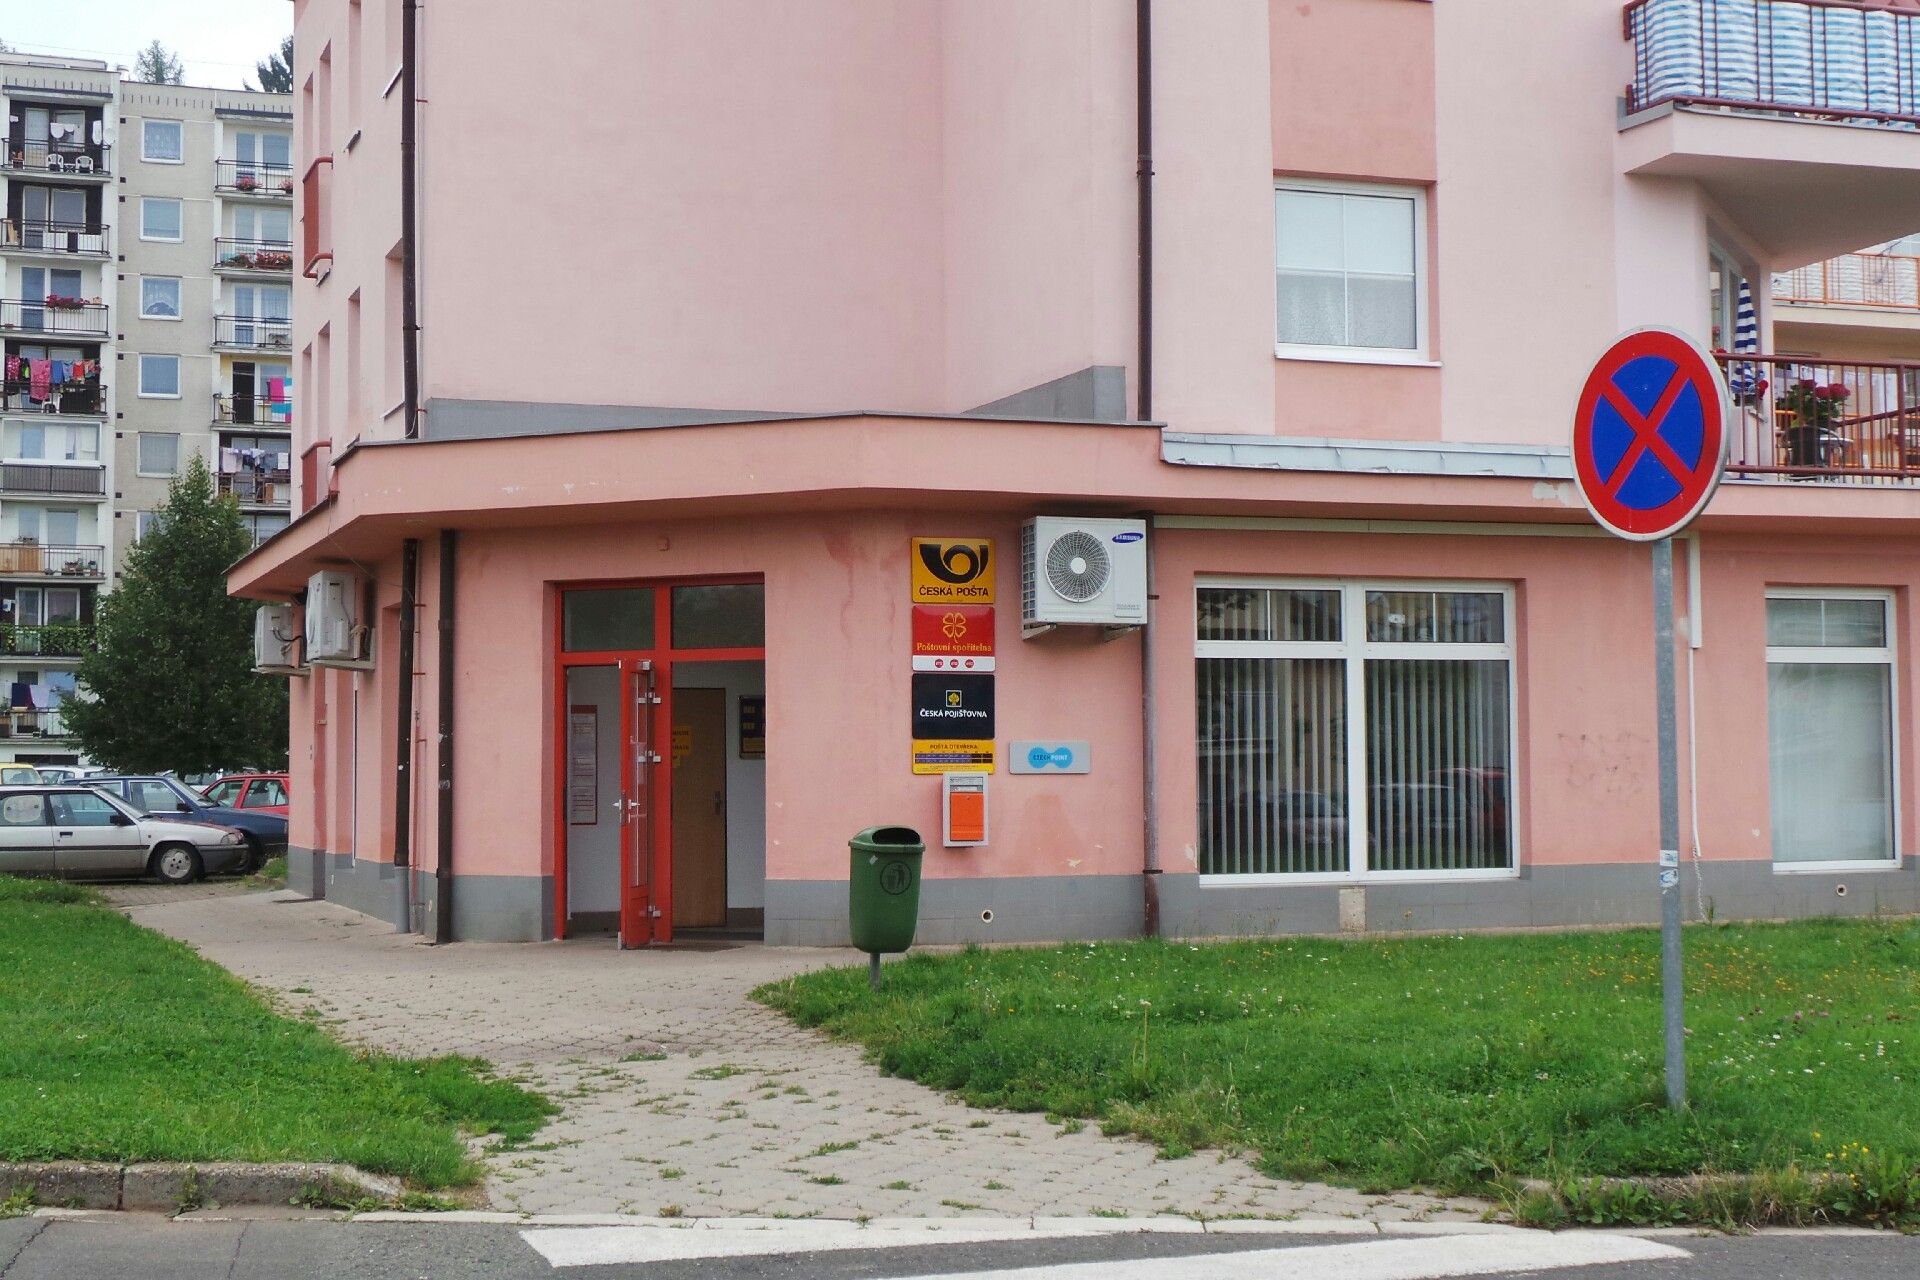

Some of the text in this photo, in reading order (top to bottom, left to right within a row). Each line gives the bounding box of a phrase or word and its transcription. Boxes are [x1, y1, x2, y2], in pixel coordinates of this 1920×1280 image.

[919, 585, 989, 596] ČESKÁ POŠTA
[916, 642, 992, 654] Poštovní spořitelna
[920, 708, 987, 718] ČESKÁ POJIŠŤOVNA
